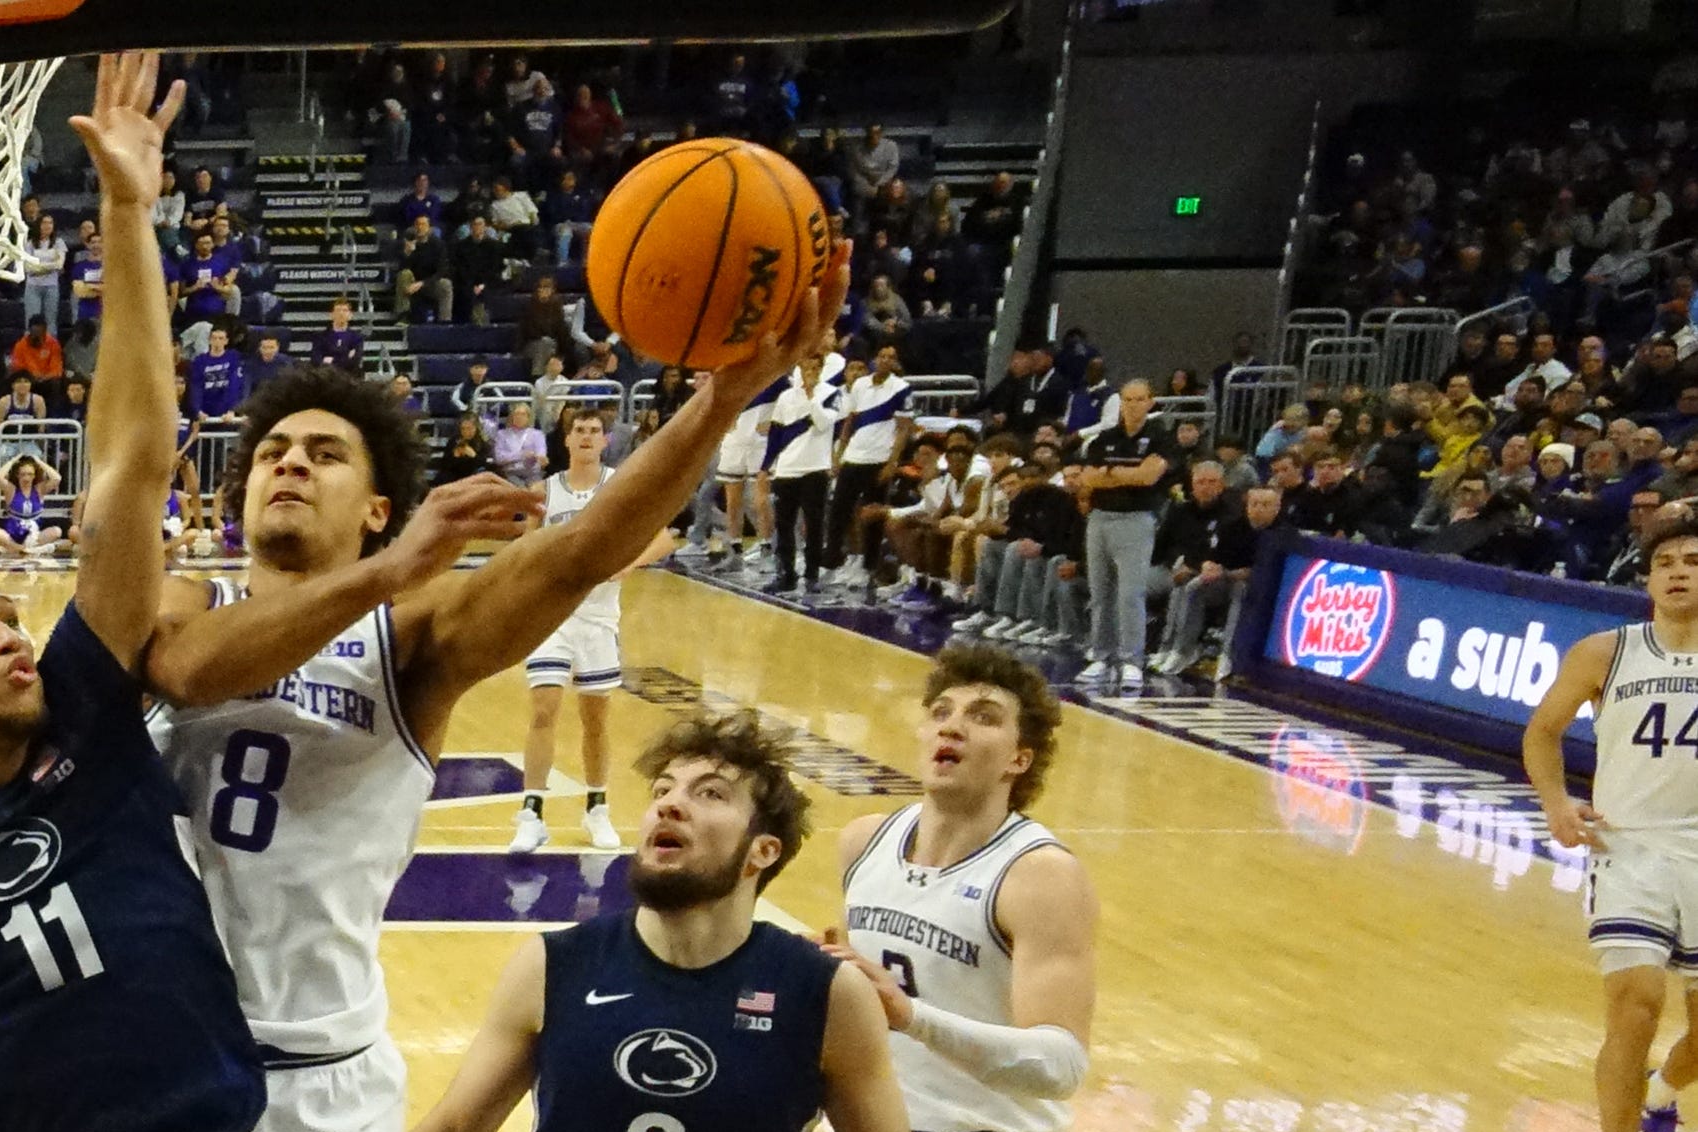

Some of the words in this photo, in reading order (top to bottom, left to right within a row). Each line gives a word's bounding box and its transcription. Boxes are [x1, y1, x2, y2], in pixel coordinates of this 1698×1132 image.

[1177, 197, 1200, 214] EXIT
[279, 270, 309, 279] PLEASE
[310, 270, 338, 279] WATCH
[1301, 574, 1382, 623] Jersey
[1407, 618, 1445, 680] a
[1451, 621, 1559, 707] sub
[1632, 702, 1698, 758] 44
[210, 728, 291, 853] 8
[0, 881, 104, 992] 11
